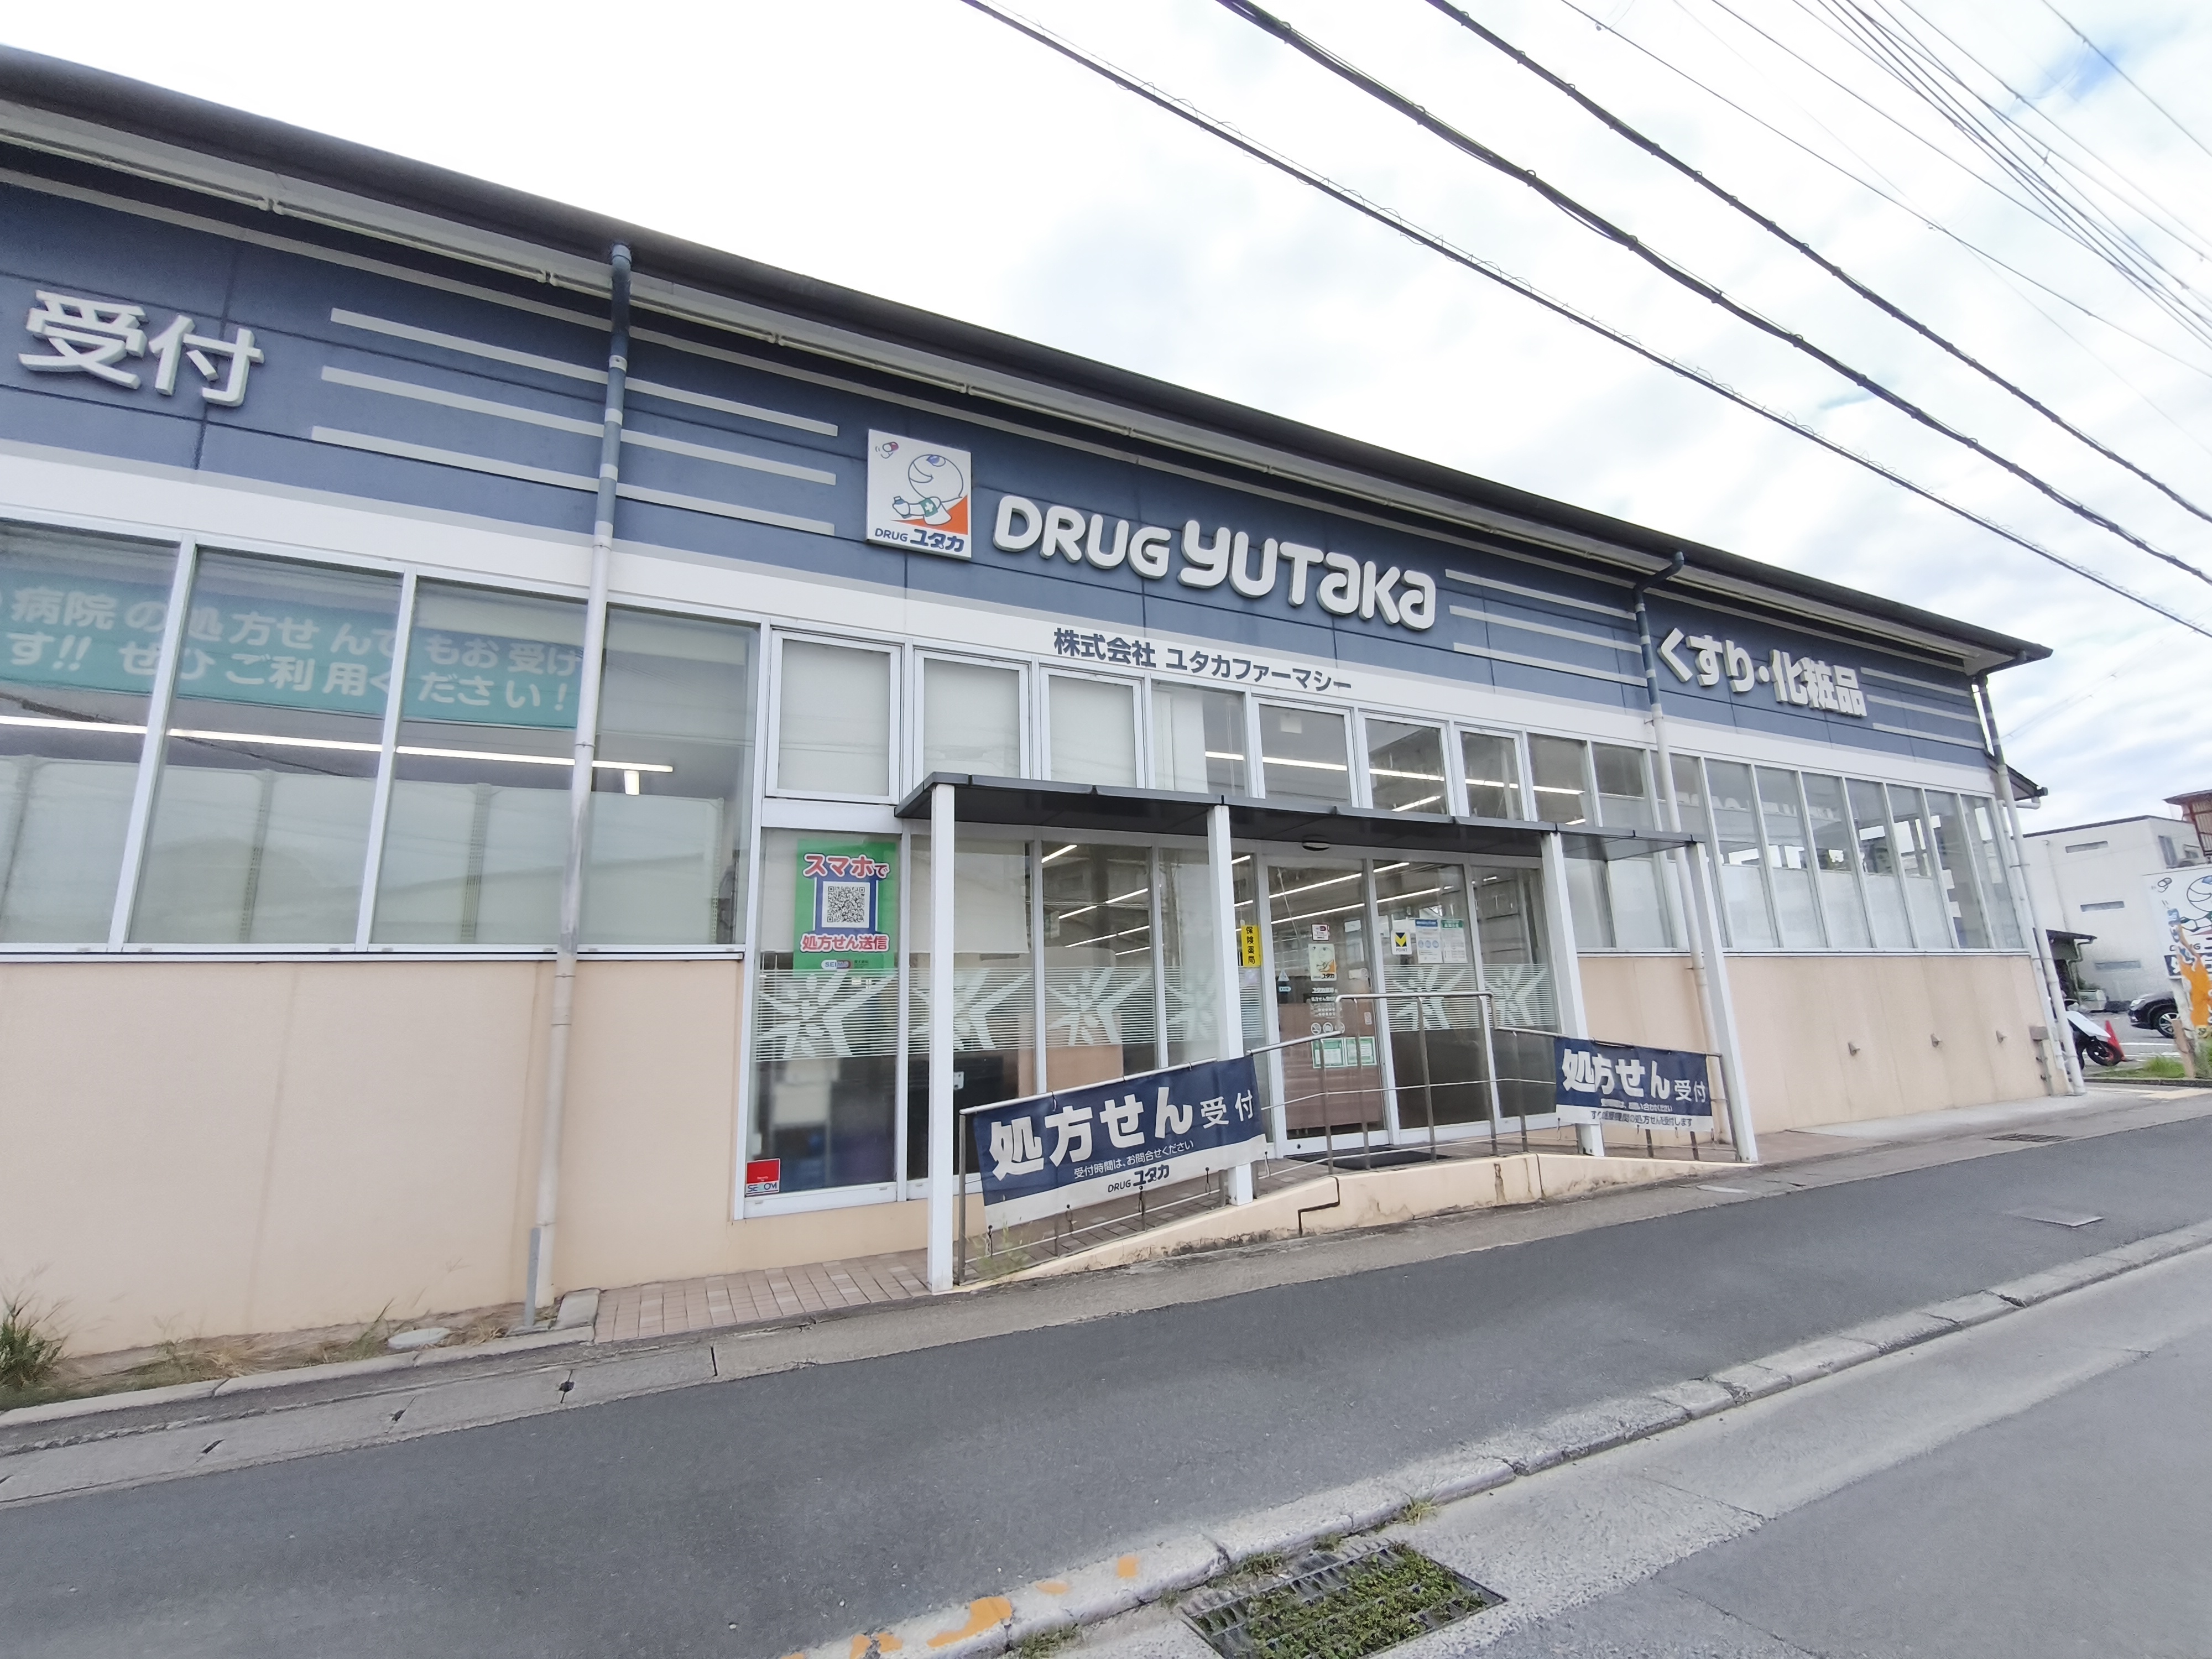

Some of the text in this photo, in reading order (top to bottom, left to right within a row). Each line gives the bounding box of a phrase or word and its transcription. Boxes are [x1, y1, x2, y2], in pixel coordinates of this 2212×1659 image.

[18, 289, 264, 407] 受付
[874, 528, 965, 552] DRUG ユタカ
[993, 495, 1171, 579] DRUG
[1053, 628, 1352, 692] 株式会社 ユタカファーマシー
[1657, 627, 1867, 717] くすり・化粧品
[804, 854, 889, 878] スマホで
[801, 934, 890, 952] 処方せん送信
[1562, 1048, 1706, 1103] 処方せん受付
[989, 1087, 1254, 1181] 処方せん受付
[1074, 1140, 1194, 1179] 受付時間は、お問合せください
[1108, 1164, 1170, 1193] DRUG ユタカ
